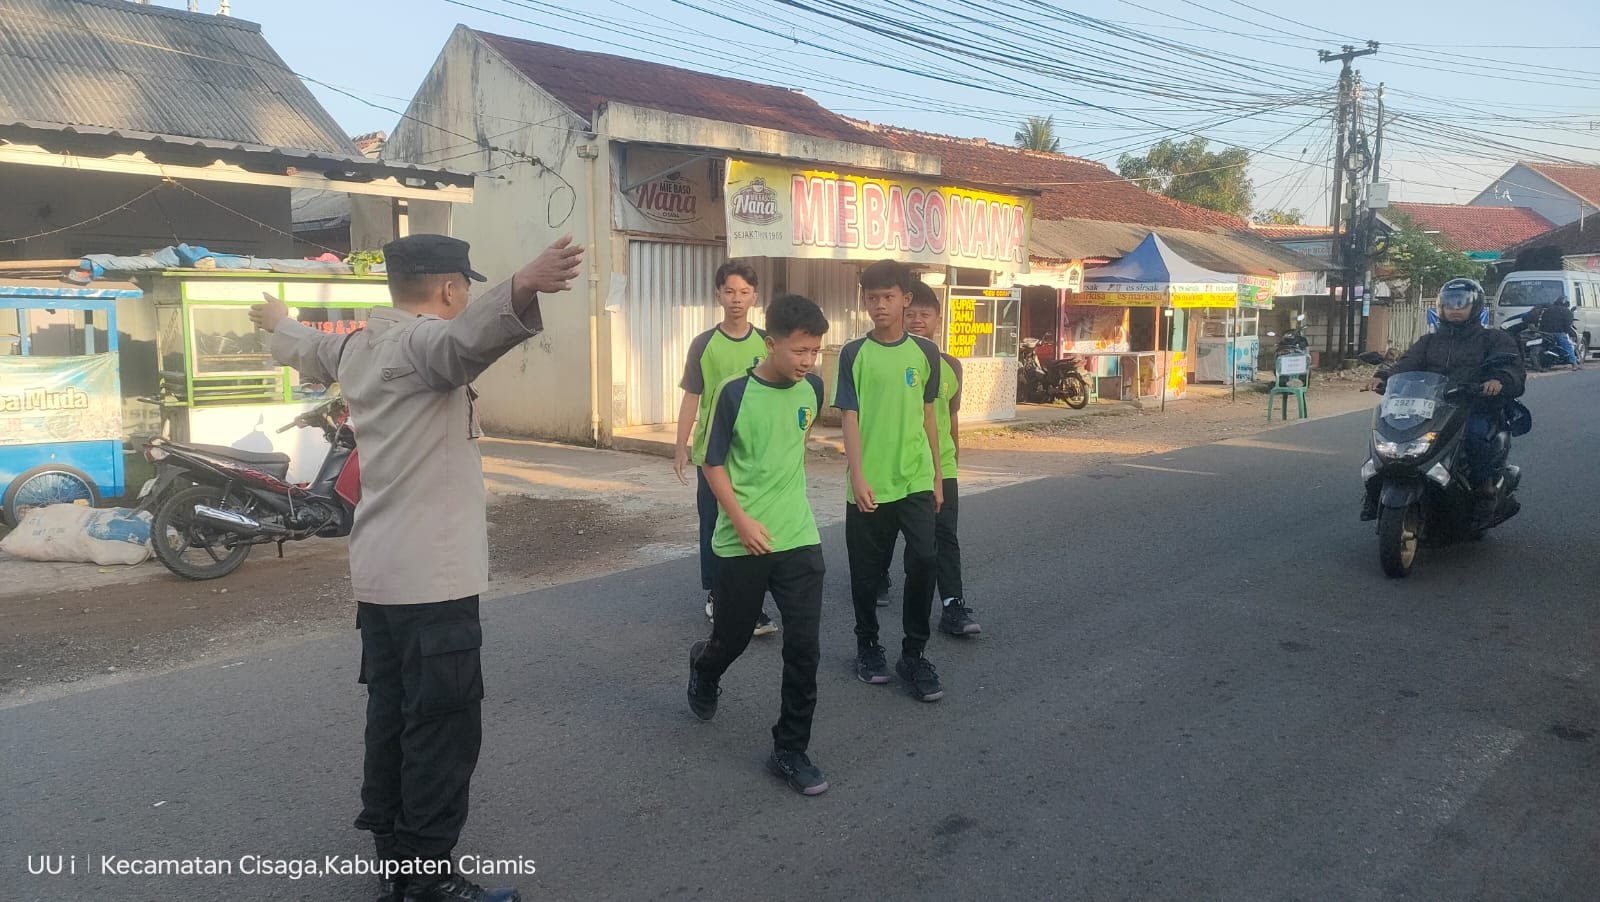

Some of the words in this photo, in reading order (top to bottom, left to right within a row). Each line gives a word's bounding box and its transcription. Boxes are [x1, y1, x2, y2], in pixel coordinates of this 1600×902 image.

[637, 182, 697, 214] Nana
[659, 182, 672, 193] MIE
[673, 183, 691, 194] BASO
[734, 194, 775, 215] Nana
[791, 174, 859, 248] MIE
[862, 182, 947, 255] BASO
[950, 193, 1024, 264] NANA
[949, 346, 971, 358] AYAM
[24, 386, 89, 411] Muda
